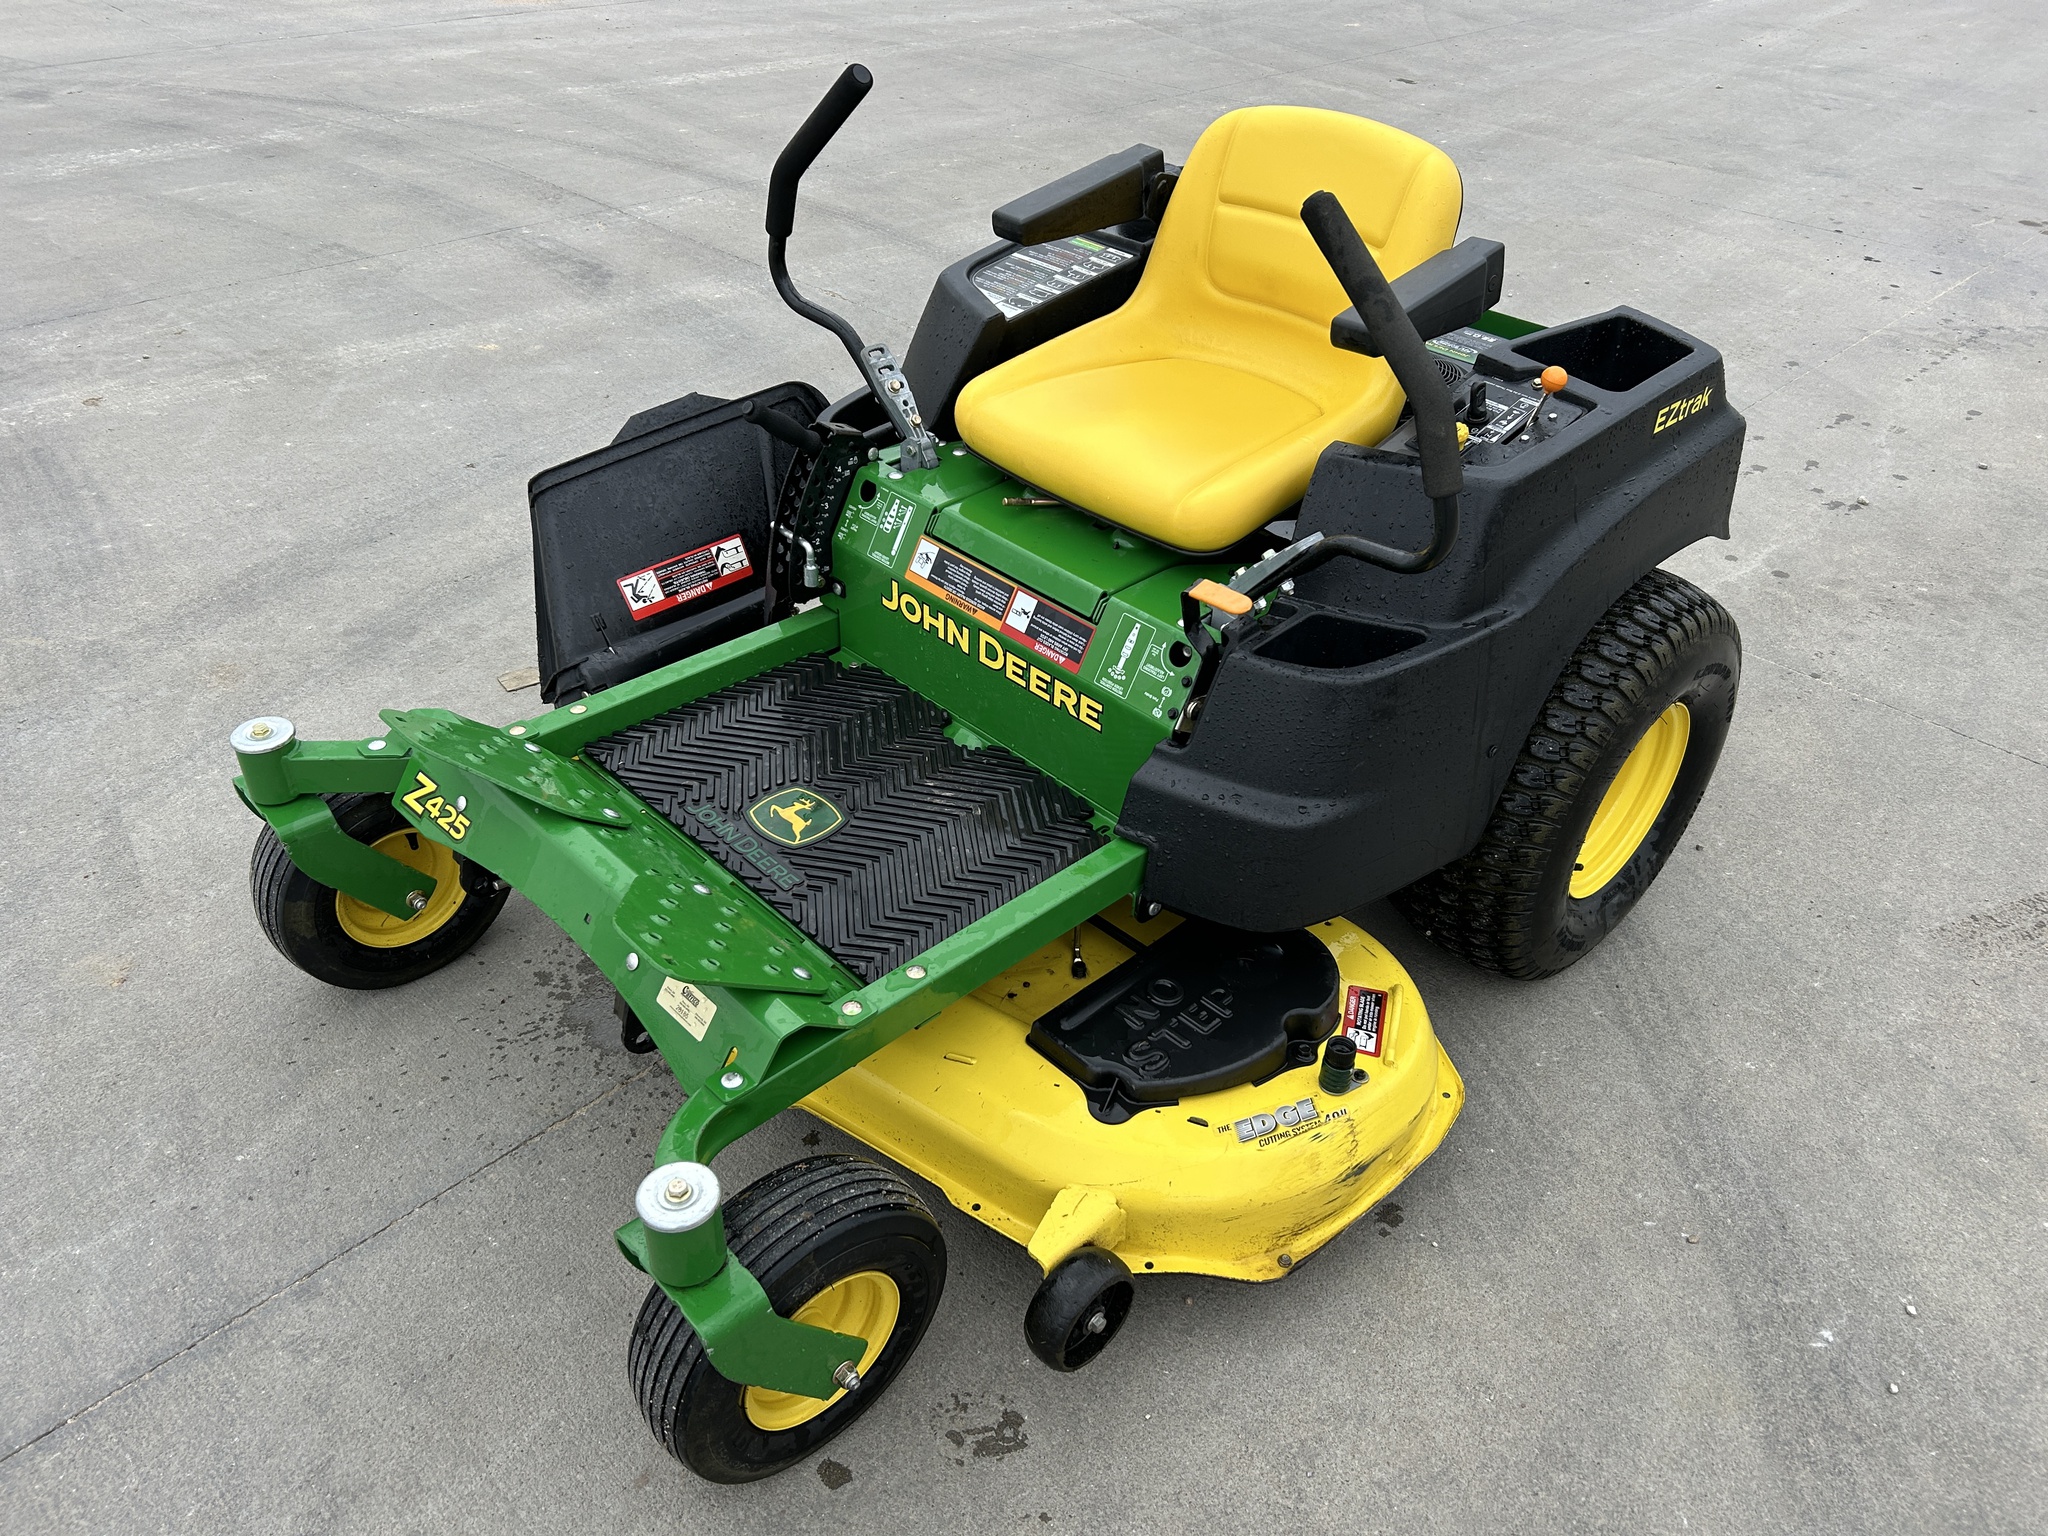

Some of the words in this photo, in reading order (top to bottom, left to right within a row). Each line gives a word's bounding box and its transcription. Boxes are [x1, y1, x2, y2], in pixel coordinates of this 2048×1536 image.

[1653, 386, 1714, 435] EZtrak
[676, 584, 706, 602] DANGER
[943, 592, 972, 612] WARNING
[882, 580, 970, 655] JOHN
[978, 629, 1103, 732] DEERE
[1033, 642, 1059, 660] DANGER
[402, 771, 471, 840] Z425
[687, 804, 741, 842] JOHN
[733, 836, 800, 889] DEERE
[1114, 979, 1184, 1031] NO
[1348, 996, 1356, 1014] DANGER
[1122, 988, 1234, 1079] STEP
[1217, 1123, 1232, 1134] THE
[1233, 1097, 1319, 1143] EDGE
[1258, 1130, 1292, 1148] CUTTING
